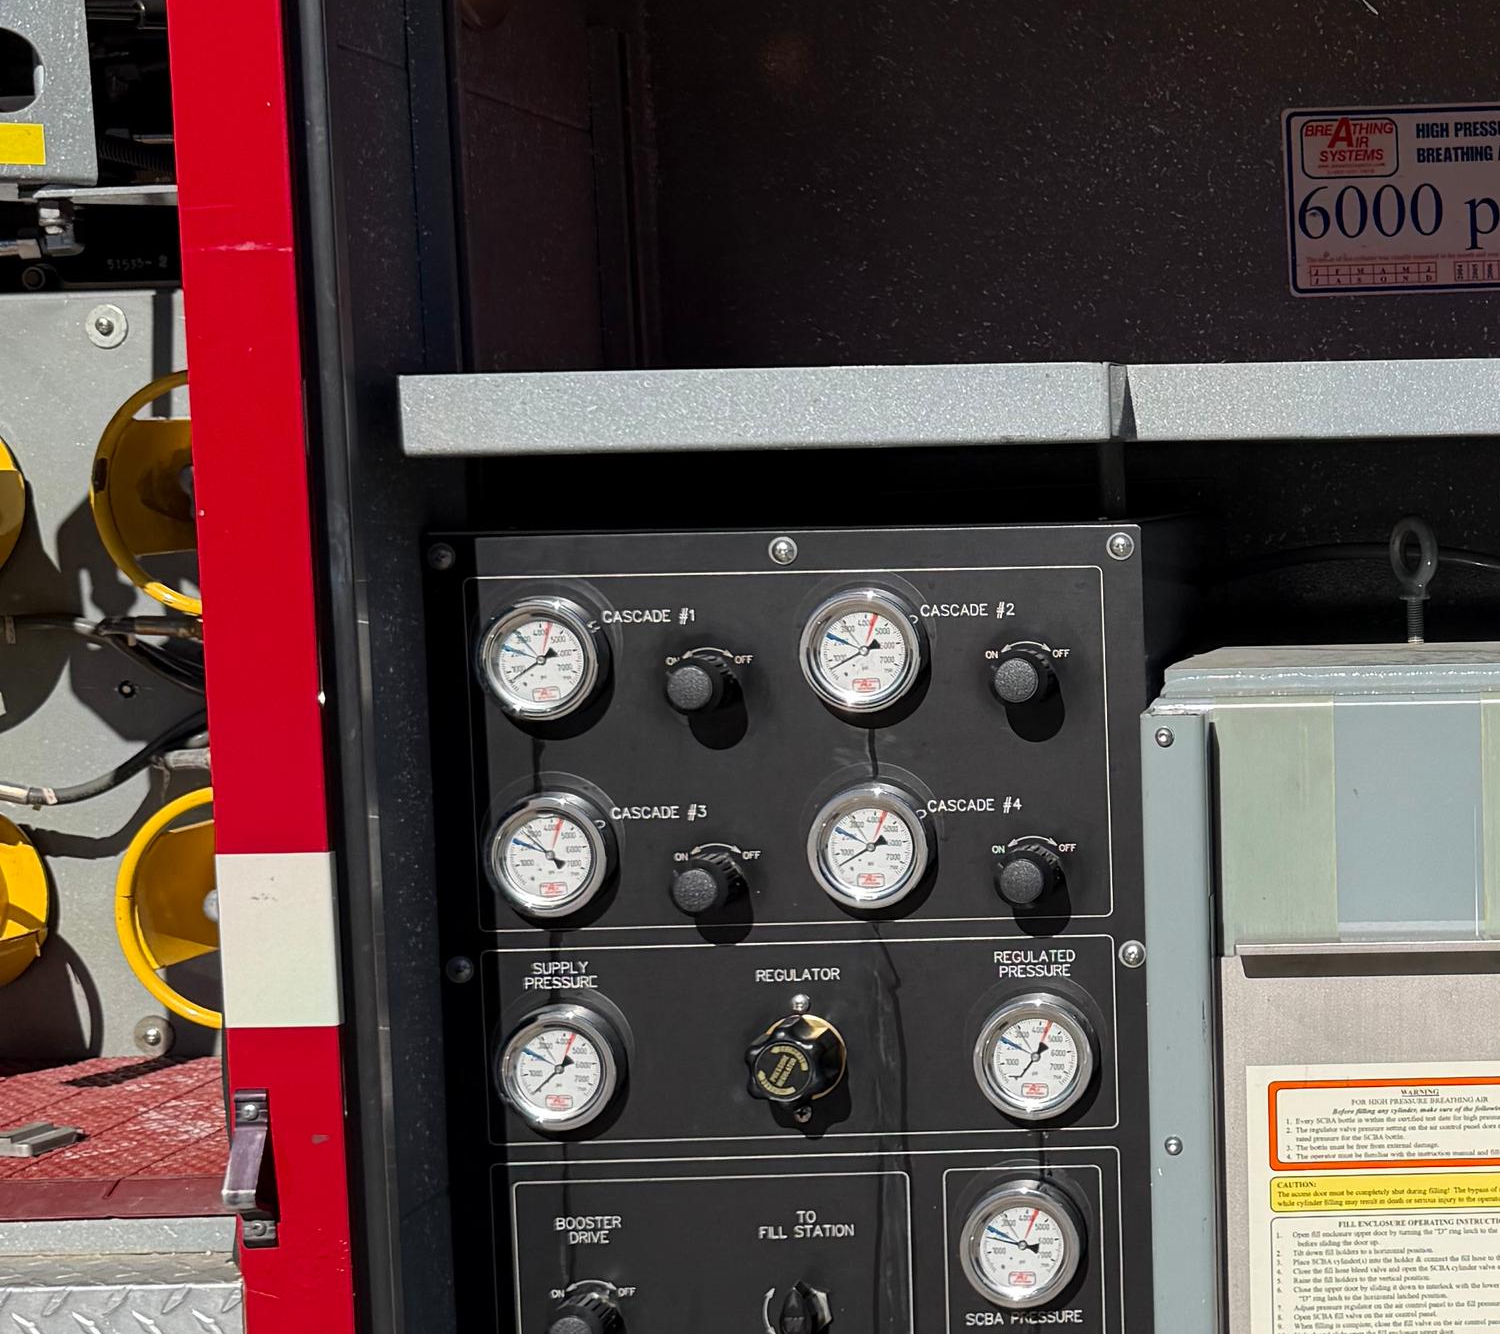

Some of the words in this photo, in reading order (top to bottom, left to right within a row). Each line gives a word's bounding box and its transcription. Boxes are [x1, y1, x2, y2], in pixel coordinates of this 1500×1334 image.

[1416, 123, 1449, 139] HIGH
[1319, 149, 1383, 162] SYSTEMS
[1417, 146, 1493, 163] BREATHING
[1299, 183, 1443, 239] 6000
[603, 610, 671, 623] CASCADE
[679, 607, 695, 625] #1
[920, 604, 988, 617] CASCADE
[996, 602, 1015, 619] #2
[734, 655, 753, 664] OFF
[985, 650, 998, 659] ON
[1053, 649, 1070, 658] OFF
[928, 799, 995, 812] CASCADE
[1003, 797, 1022, 813] #4
[610, 806, 679, 819] CASCADE
[688, 804, 707, 821] #3
[992, 845, 1005, 853] ON
[1059, 844, 1076, 852] OFF
[674, 853, 688, 861] ON
[742, 851, 760, 860] OFF
[994, 950, 1076, 963] REGULATED
[532, 961, 588, 974] SUPPLY
[999, 965, 1071, 977] PRESSURE
[755, 968, 840, 982] REGULATOR
[524, 975, 598, 989] PRESSURE
[554, 1216, 622, 1230] BOOSTER
[797, 1211, 816, 1224] TO
[568, 1230, 609, 1244] DRIVE
[759, 1226, 787, 1239] FILL
[793, 1224, 854, 1238] STATION
[551, 1288, 565, 1299] ON
[618, 1287, 636, 1297] OFF
[966, 1313, 1004, 1326] SCBA
[1011, 1310, 1083, 1324] PRESSURE
